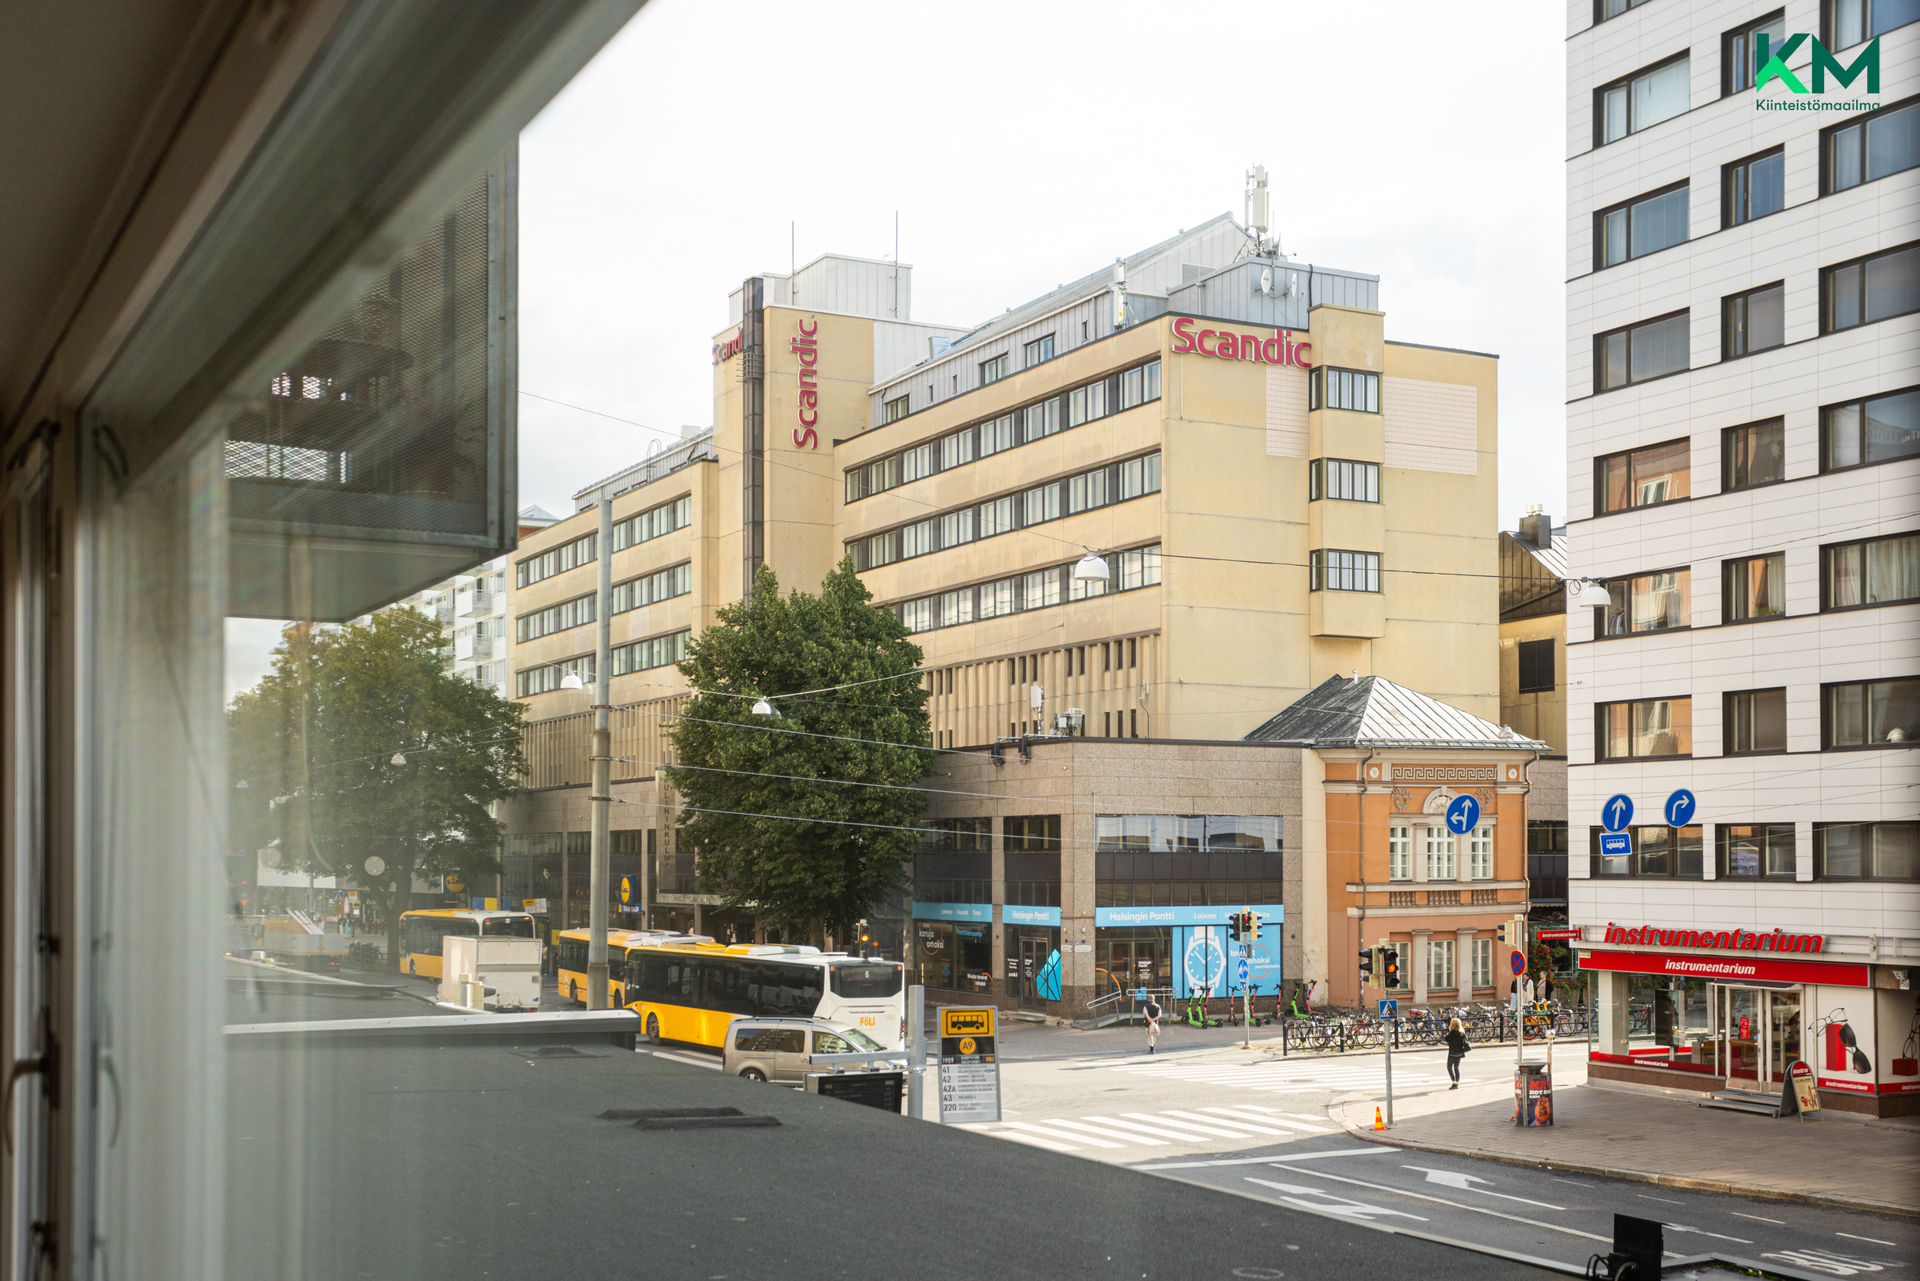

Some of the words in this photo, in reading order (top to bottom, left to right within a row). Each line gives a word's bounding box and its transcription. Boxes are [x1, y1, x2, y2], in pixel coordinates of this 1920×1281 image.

[711, 326, 744, 366] Scandi
[1172, 317, 1312, 369] Scandic
[790, 319, 818, 449] Scandic
[1012, 910, 1034, 922] Helsingin
[1034, 911, 1050, 921] Pantti
[1109, 911, 1148, 923] Helsingin
[1149, 911, 1175, 920] Pantti
[918, 928, 934, 940] koruja
[1603, 921, 1823, 953] instrumentarium
[926, 939, 944, 949] omaksi
[1665, 959, 1756, 975] instrumentarium
[864, 970, 870, 979] 6
[860, 1016, 876, 1027] FÖLI
[962, 1041, 973, 1050] A9
[942, 1056, 955, 1064] 1909
[1634, 1058, 1669, 1068] instrumentarium
[942, 1065, 950, 1074] 41
[942, 1075, 952, 1083] 42
[942, 1085, 957, 1093] 42A
[1825, 1080, 1868, 1091] instrumentarium
[943, 1094, 953, 1102] 43
[943, 1103, 957, 1112] 220
